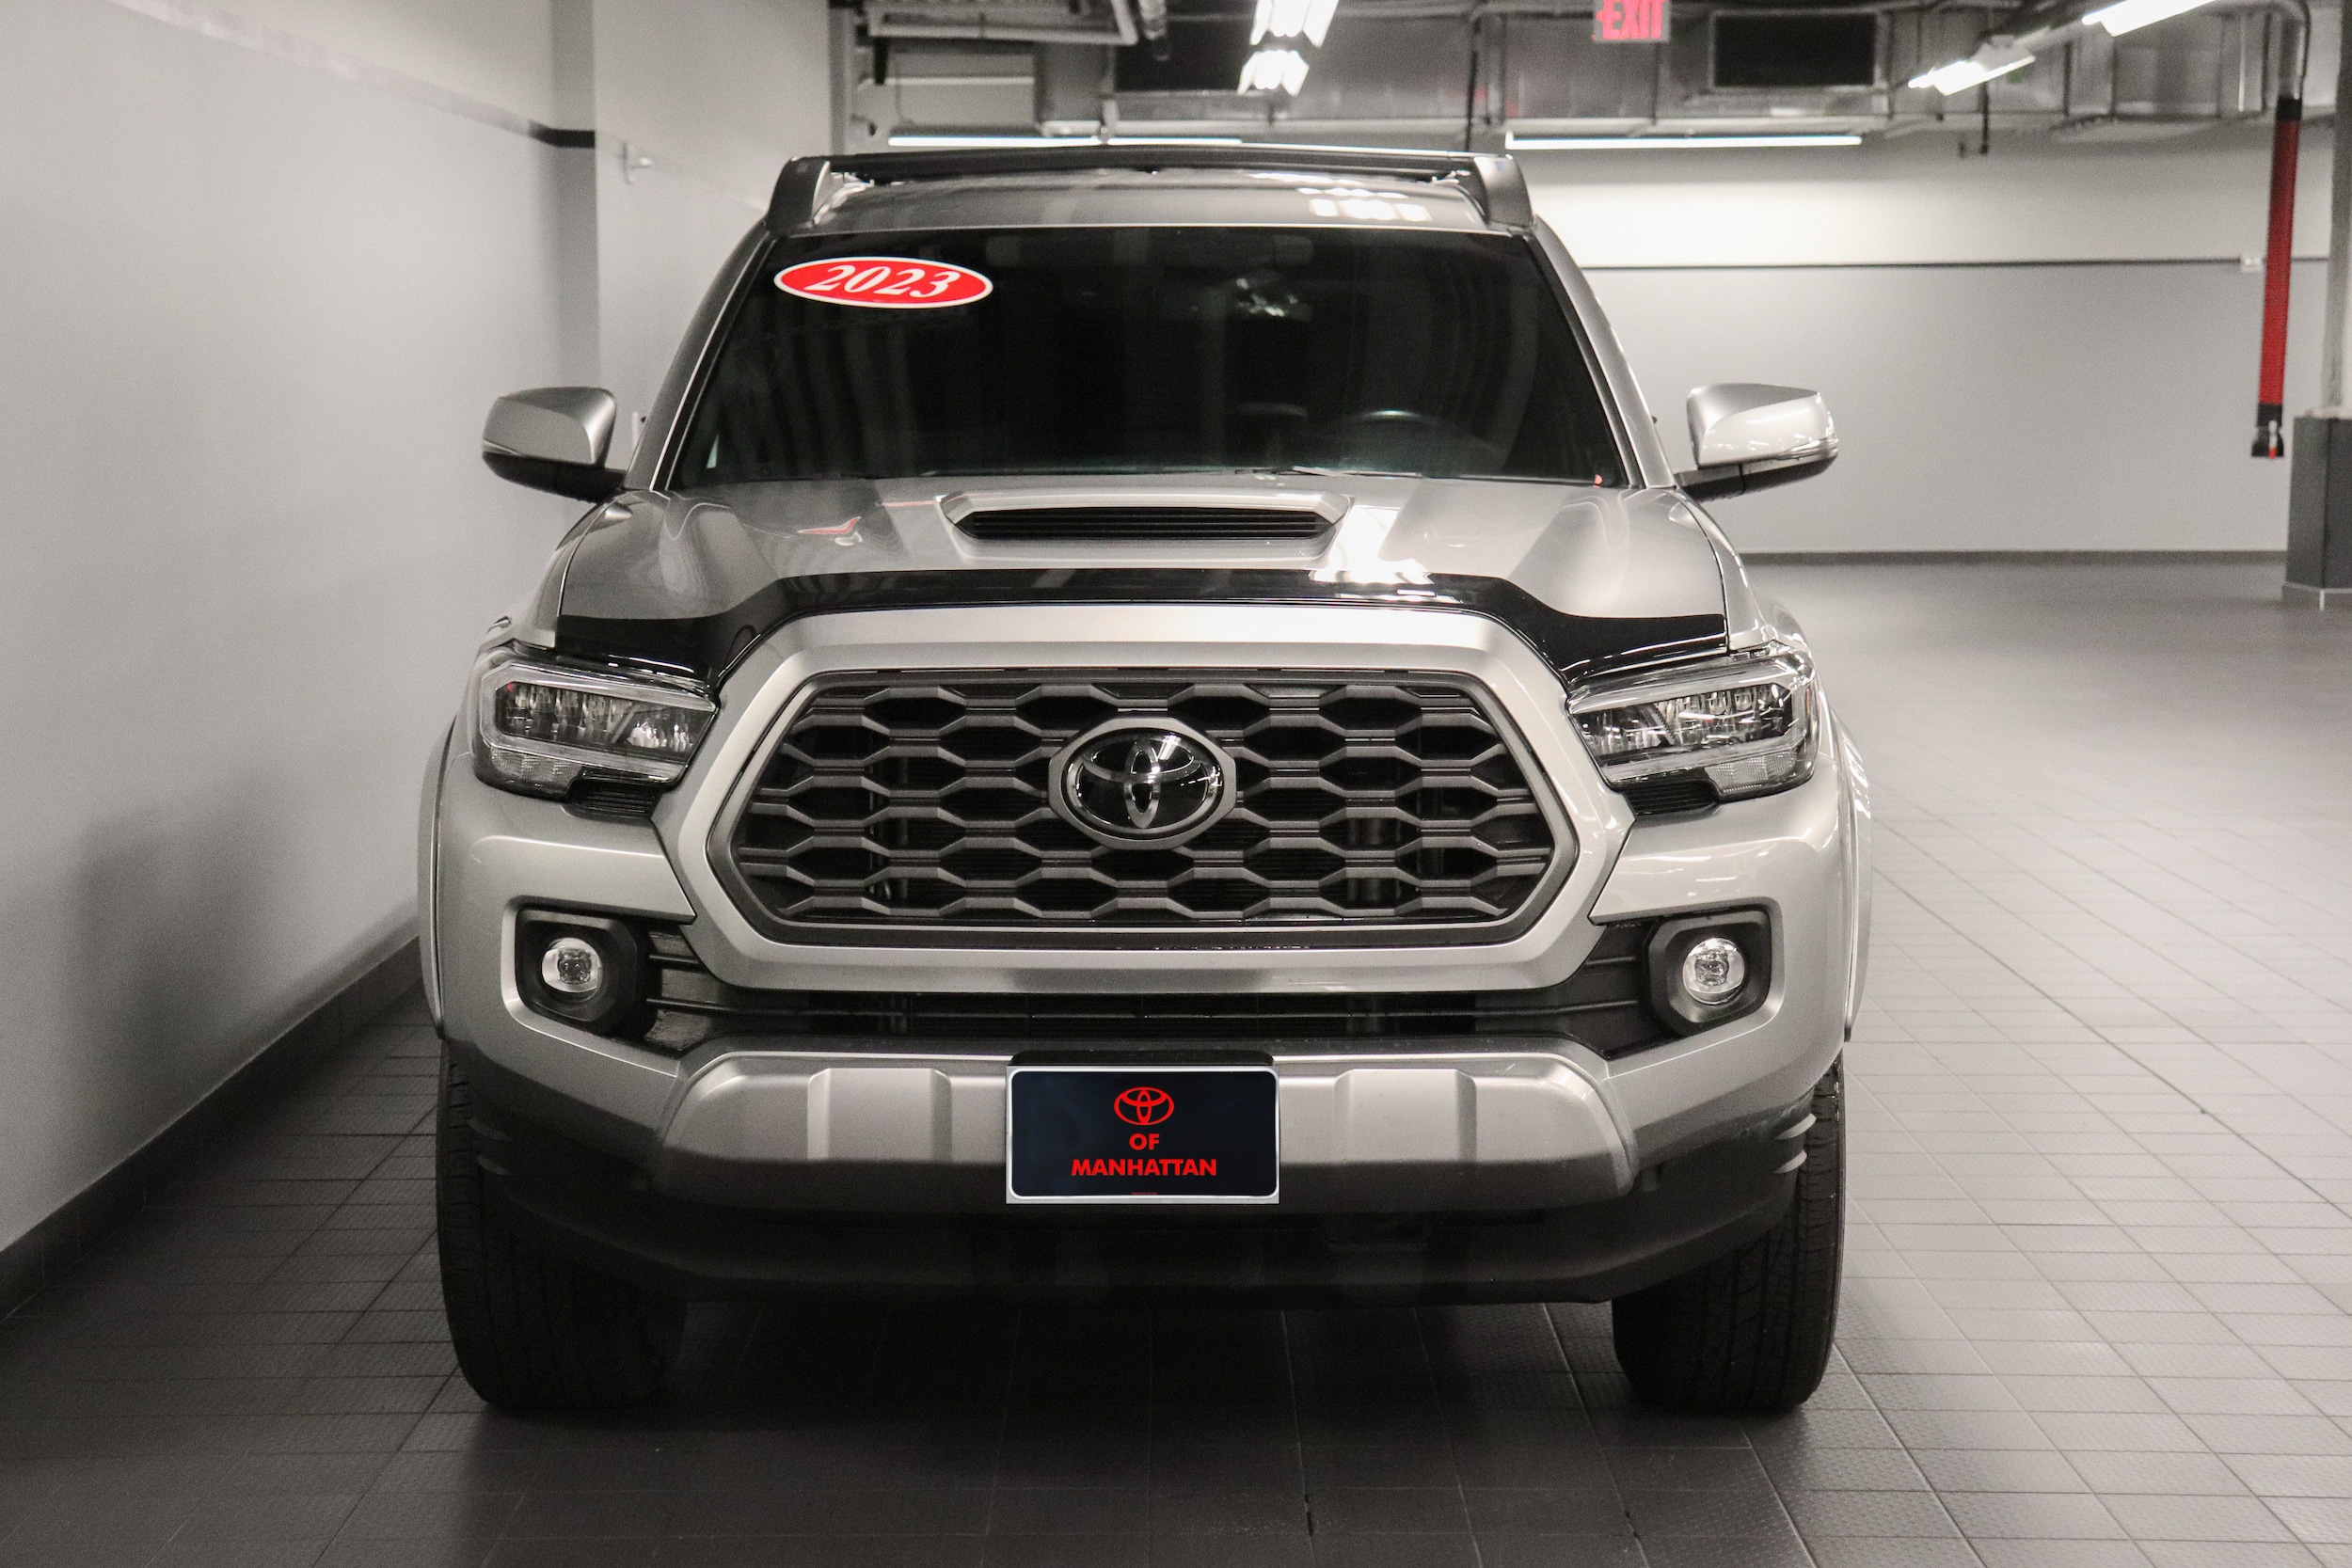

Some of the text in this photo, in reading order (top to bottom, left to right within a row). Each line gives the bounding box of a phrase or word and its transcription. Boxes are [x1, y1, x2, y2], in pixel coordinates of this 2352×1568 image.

[1601, 0, 1667, 40] EXIT
[803, 264, 961, 298] 2023
[1129, 1132, 1160, 1150] OF
[1071, 1158, 1216, 1176] MANHATTAN
